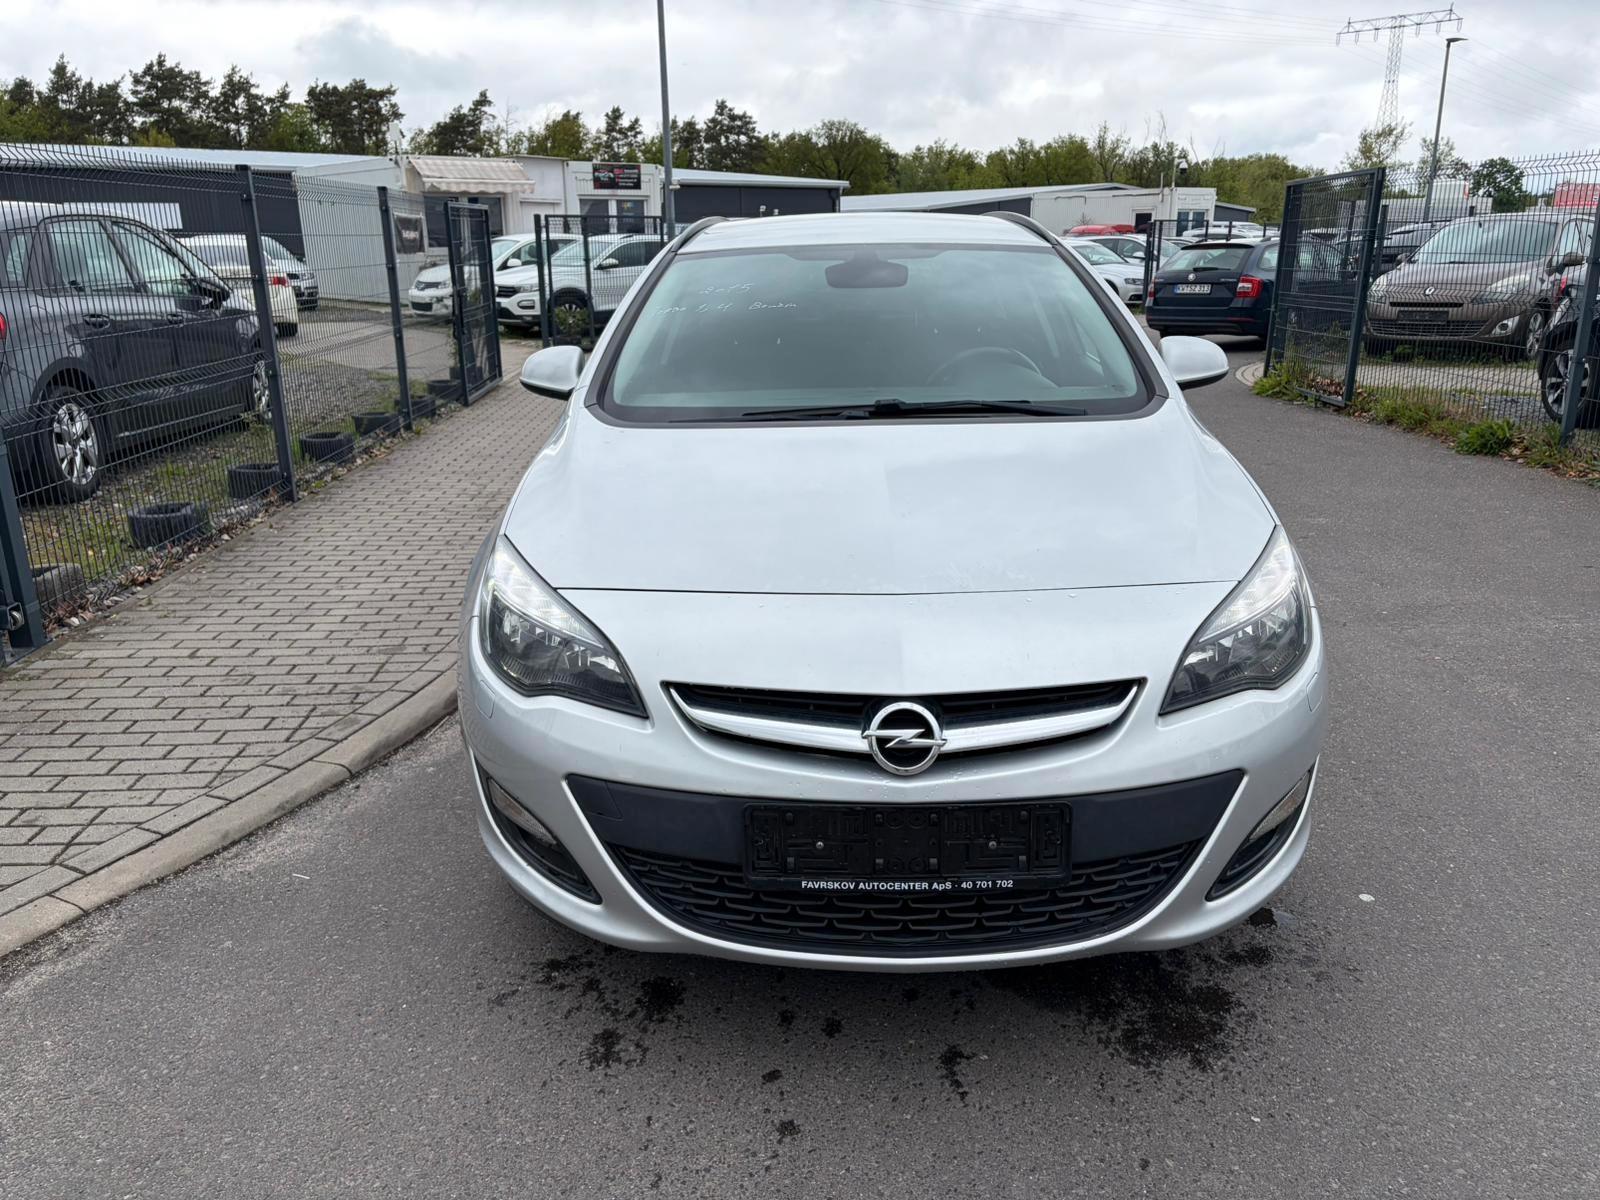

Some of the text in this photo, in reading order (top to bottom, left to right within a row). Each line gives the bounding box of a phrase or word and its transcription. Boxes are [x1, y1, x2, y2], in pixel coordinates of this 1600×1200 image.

[801, 880, 1014, 891] FAVRSKOV AUTOCENTER ApS 40 701 702
